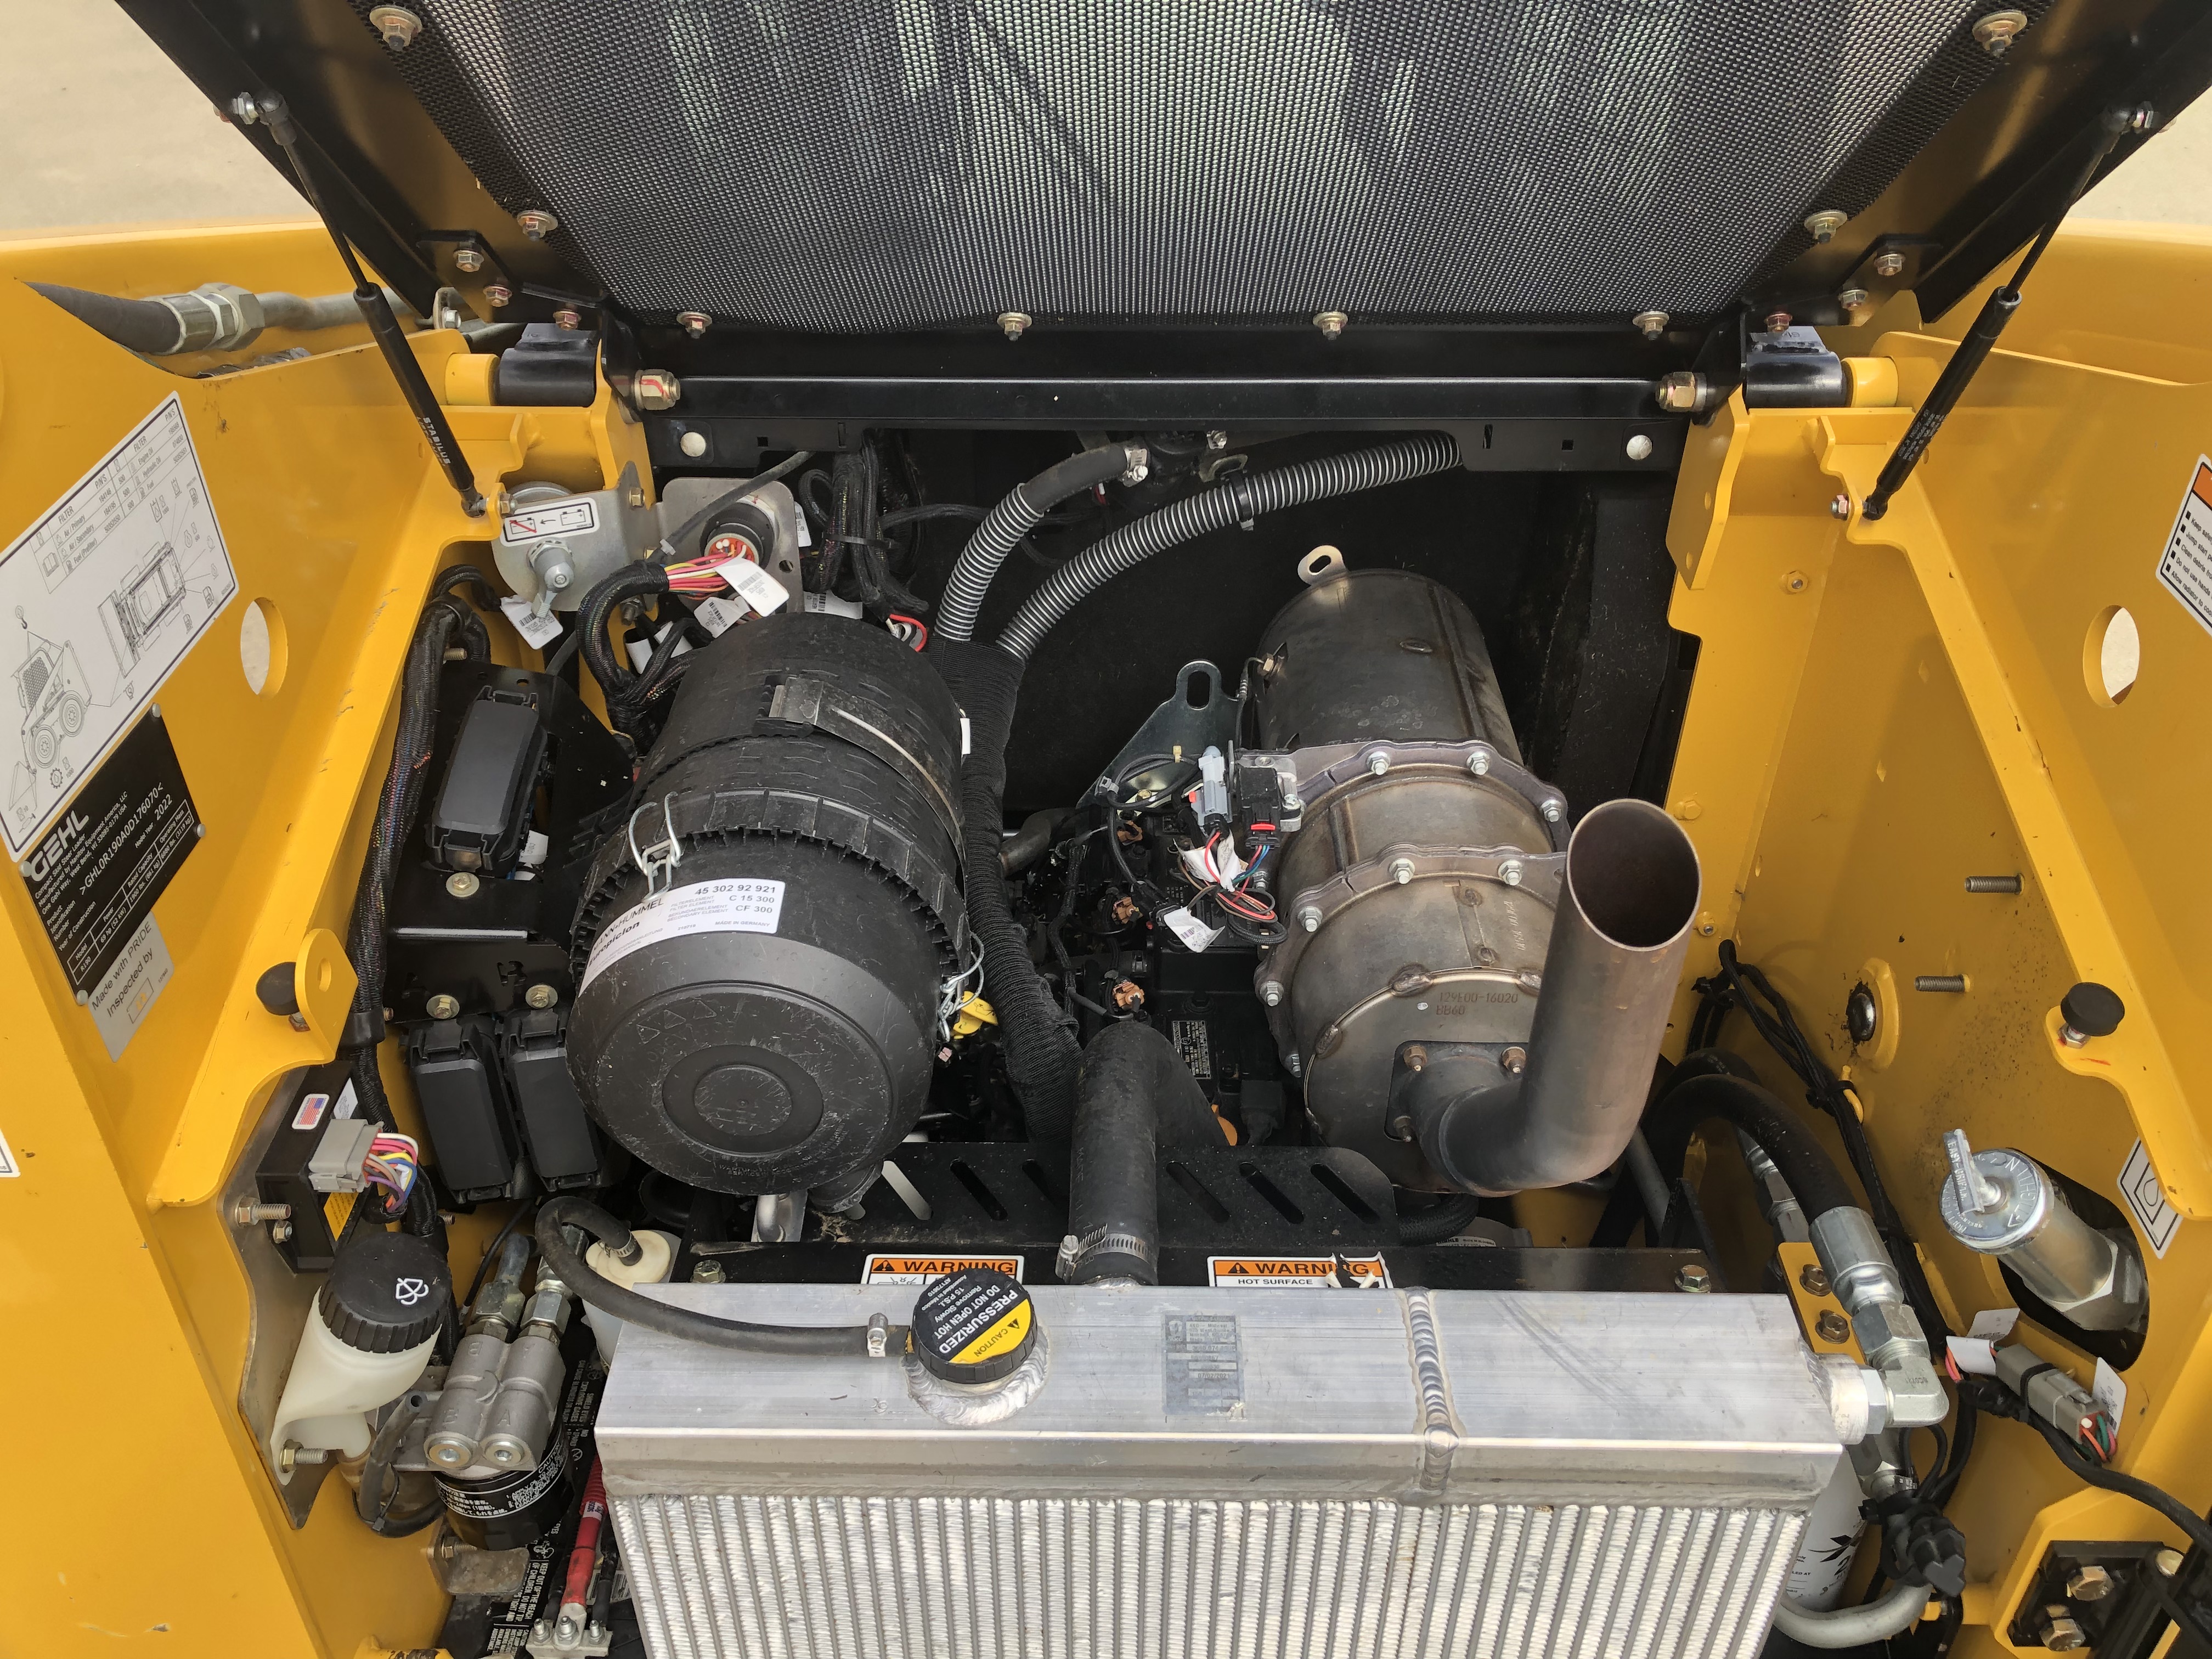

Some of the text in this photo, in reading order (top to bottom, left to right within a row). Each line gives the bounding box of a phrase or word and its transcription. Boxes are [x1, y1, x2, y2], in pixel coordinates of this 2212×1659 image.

[134, 436, 147, 452] FILTER
[423, 417, 451, 464] STABILUS
[138, 453, 149, 465] Engine
[58, 474, 107, 524] FILTER P/N'S
[72, 515, 86, 532] Primary
[76, 524, 94, 544] Secondary
[2191, 517, 2202, 532] Keep
[2186, 532, 2208, 556] Jump start
[74, 553, 82, 563] Fuel
[2181, 544, 2205, 573] Clean debris
[2171, 571, 2203, 607] Allow radiator to
[2176, 557, 2182, 565] Do
[2190, 572, 2198, 583] use
[2198, 579, 2211, 596] hands
[135, 794, 172, 848] Model Year 2022
[31, 810, 89, 881] GEHL
[38, 791, 128, 907] Manufactured by Manitou Equipment America, LLC
[35, 833, 86, 899] Compact Skid Steer Loader
[42, 904, 51, 915] One
[51, 890, 61, 904] Gehl
[70, 865, 81, 878] West
[91, 842, 98, 850] WI
[75, 810, 184, 961] Model Power Rated Capacity Operating Mass
[671, 895, 715, 907] FILTERELEMENT
[47, 905, 63, 927] Product
[50, 900, 76, 934] Identification
[59, 900, 96, 952] Year of Construction
[667, 912, 700, 922] SECONDARY
[54, 919, 70, 942] Number
[80, 956, 92, 972] R190
[118, 907, 126, 919] kW)
[129, 889, 139, 902] 1900
[92, 921, 152, 1011] Made with PRIDE
[106, 948, 153, 1018] Inspected by
[904, 1261, 1013, 1273] WARNING
[922, 1275, 967, 1311] Assembled Mexico
[928, 1278, 951, 1297] AT173610
[938, 1287, 964, 1307] 15 P.S.I.
[934, 1285, 983, 1323] Remove Slowly
[934, 1284, 1001, 1340] DO NOT OPEN HOT
[939, 1289, 1019, 1354] PRESSURIZED
[974, 1328, 1008, 1357] CAUTION
[496, 1409, 511, 1426] A
[535, 1576, 545, 1585] OUT
[538, 1563, 549, 1575] KEEP
[506, 1598, 521, 1622] TIGHT AND
[518, 1602, 527, 1613] NOT
[530, 1592, 540, 1603] THE
[524, 1604, 537, 1620] REACH
